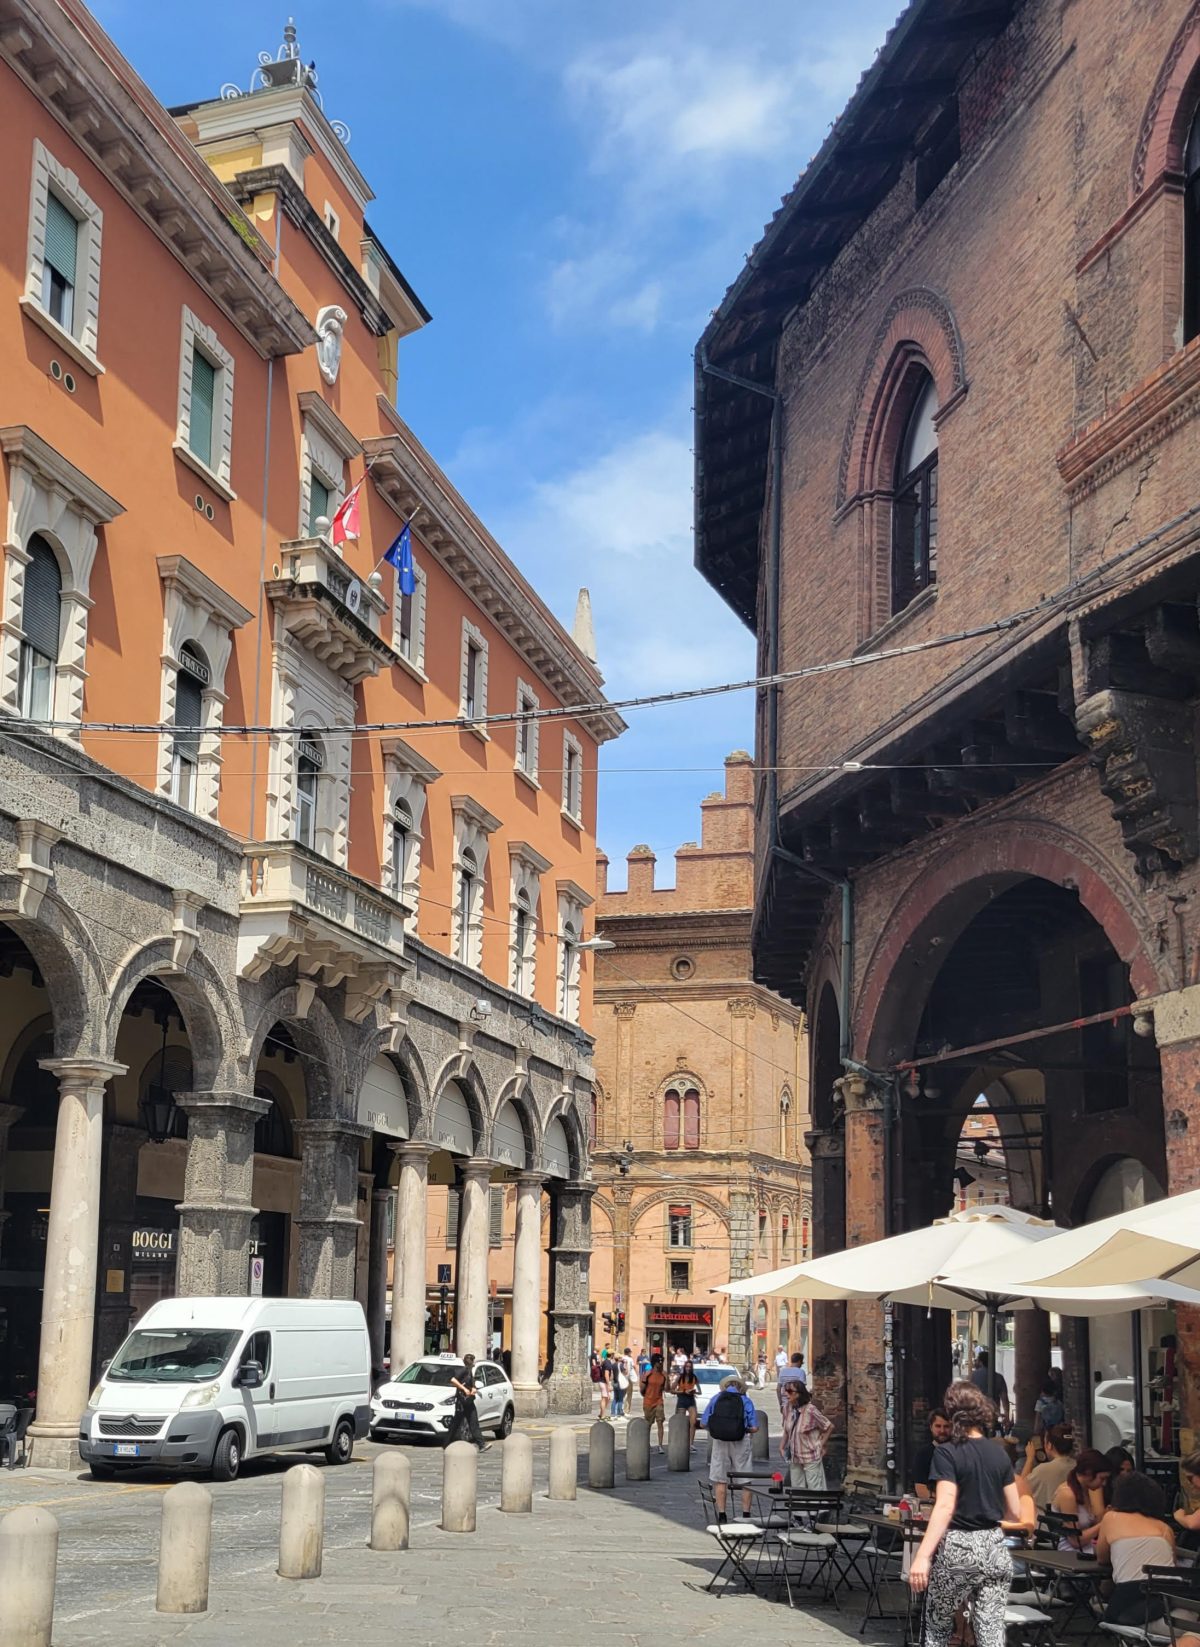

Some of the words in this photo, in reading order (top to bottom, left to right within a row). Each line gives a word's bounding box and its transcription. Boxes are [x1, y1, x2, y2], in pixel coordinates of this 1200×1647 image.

[182, 653, 208, 680] FINECO
[132, 1230, 172, 1249] BOGGI
[134, 1251, 168, 1259] MILANO
